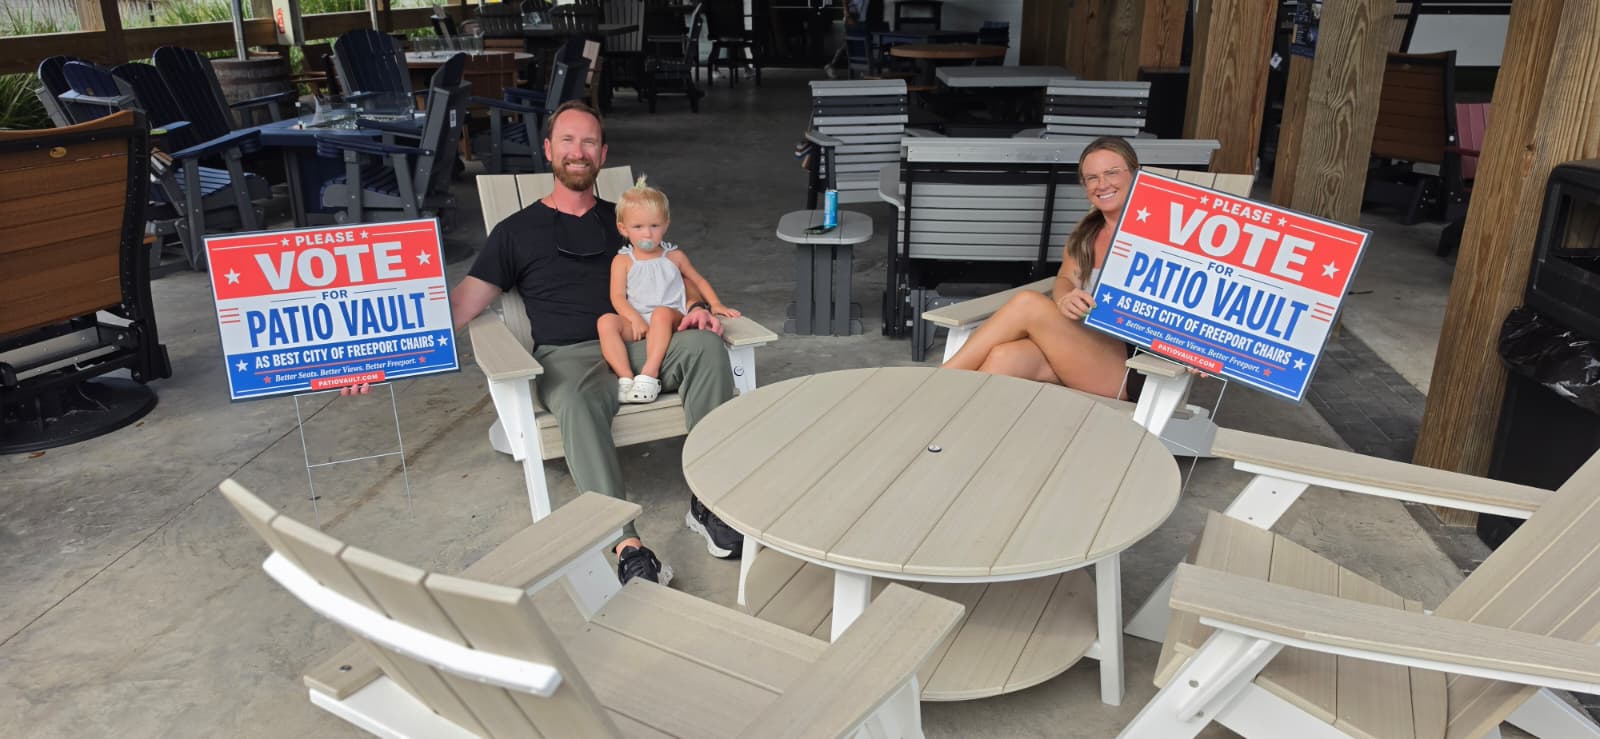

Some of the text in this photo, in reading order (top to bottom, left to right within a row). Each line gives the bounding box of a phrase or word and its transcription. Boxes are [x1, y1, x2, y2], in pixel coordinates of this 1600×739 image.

[1213, 198, 1273, 224] PLEASE
[295, 231, 355, 247] PLEASE
[1168, 201, 1316, 281] VOTE
[254, 241, 407, 291] VOTE
[1207, 262, 1234, 277] FOR
[322, 289, 348, 301] FOR
[1124, 252, 1309, 342] PATIO VAULT
[246, 292, 426, 348] PATIO VAULT
[1116, 296, 1292, 365] AS BEST CITY OF FREEPORT CHAIRS
[255, 335, 435, 369] AS BEST CITY OF FREEPORT CHAIRS
[1125, 320, 1260, 373] Better Seats. Better Views. Better Freeport.
[1157, 343, 1216, 369] PATIOVAULT.COM
[275, 358, 417, 382] Better Seats. Better Views. Better Freeport.
[318, 373, 379, 387] PATIOVAULT.COM
